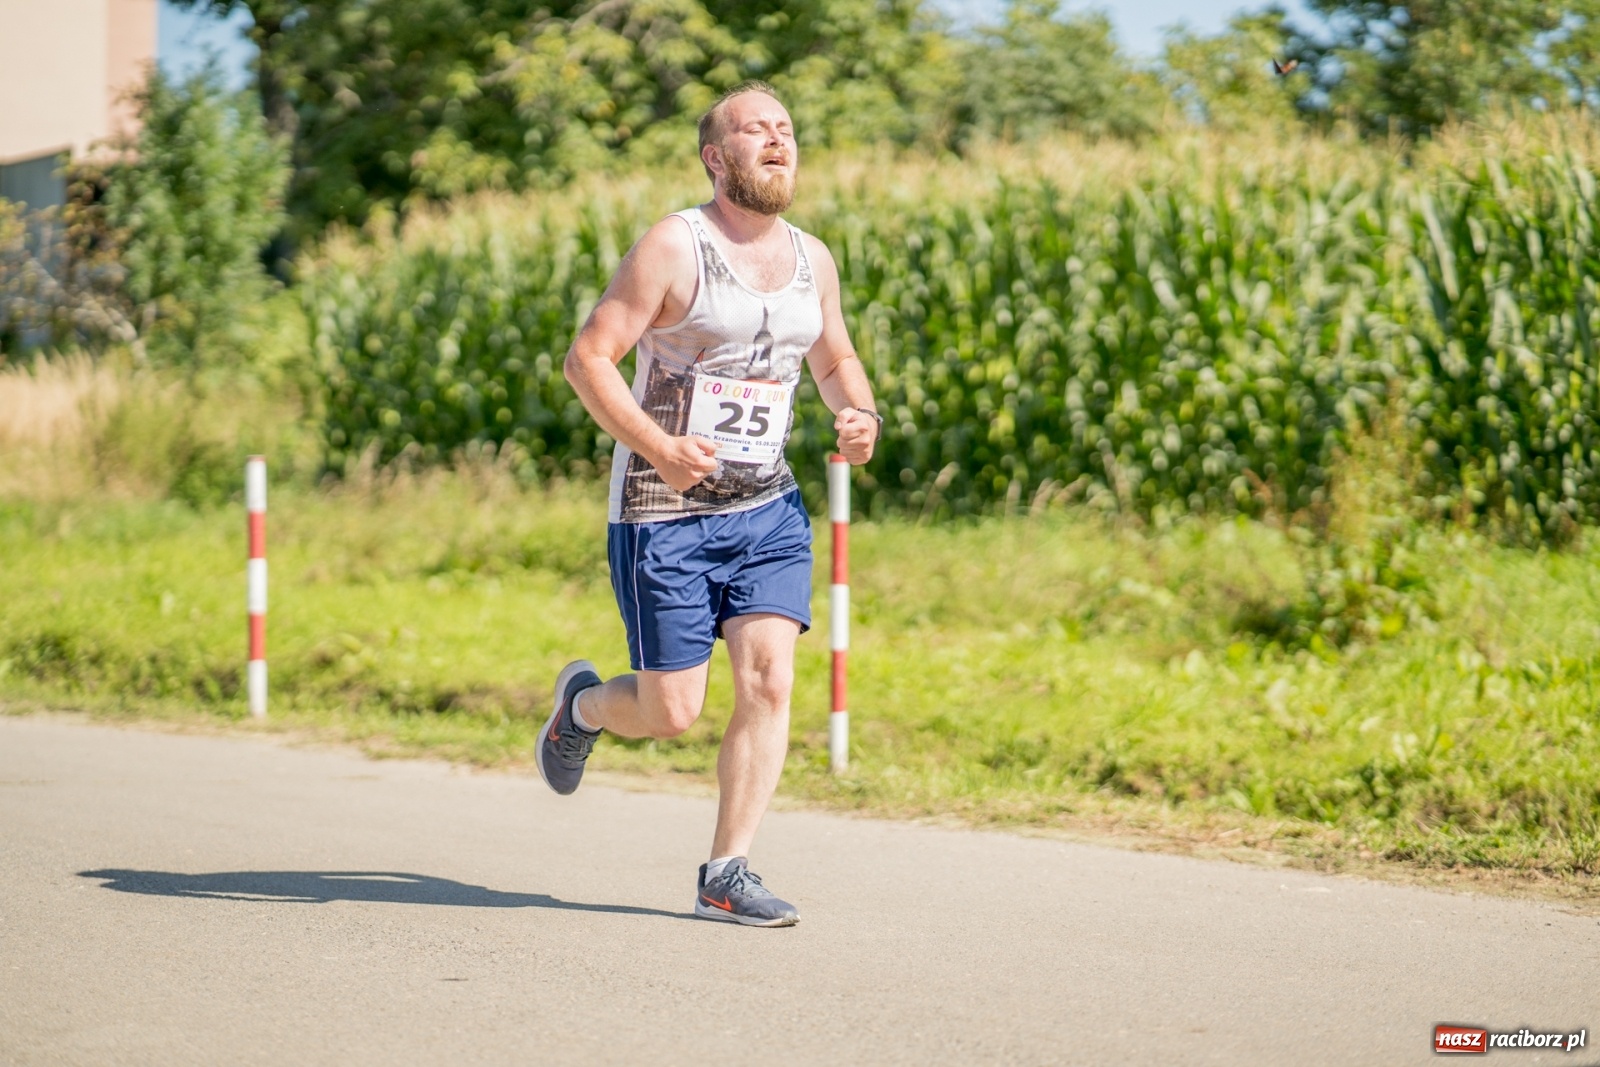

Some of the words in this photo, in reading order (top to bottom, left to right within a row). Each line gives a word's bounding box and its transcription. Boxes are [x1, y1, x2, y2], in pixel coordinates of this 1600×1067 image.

[703, 381, 760, 402] COLOUR
[766, 390, 786, 403] RUN
[714, 401, 771, 437] 25
